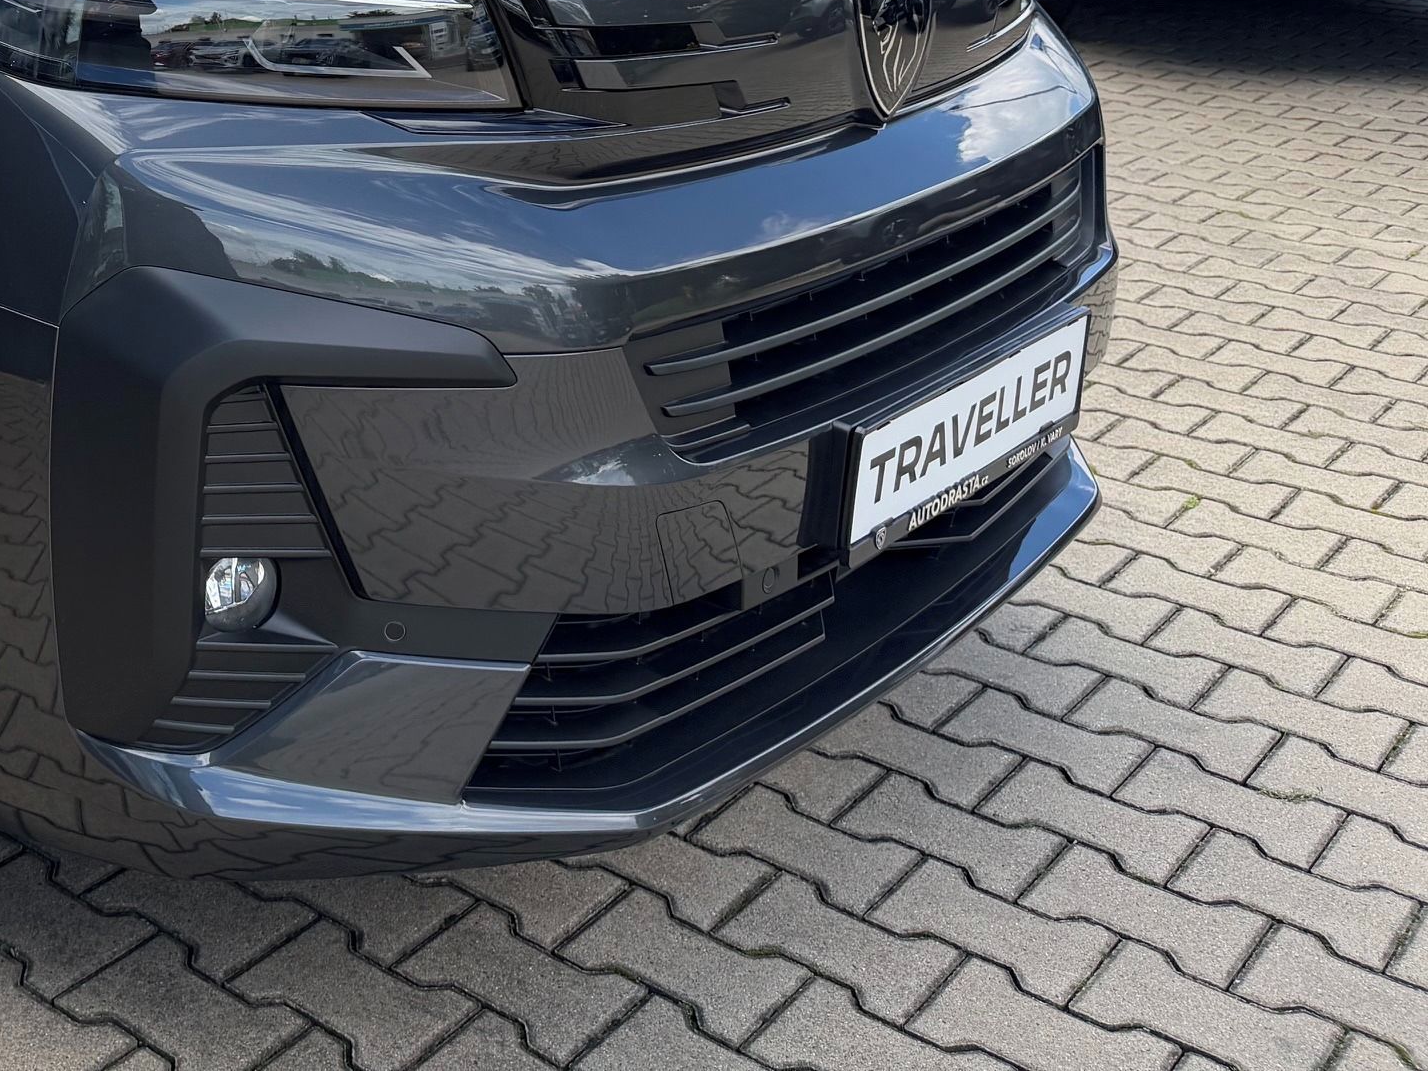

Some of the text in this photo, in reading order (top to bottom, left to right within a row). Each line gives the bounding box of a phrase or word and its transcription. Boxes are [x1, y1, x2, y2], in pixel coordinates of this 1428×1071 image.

[870, 350, 1072, 504] TRAVELLER
[1007, 442, 1037, 468] SOKOLOV
[1047, 426, 1063, 442] VARY
[908, 473, 989, 531] AUTODRASTA.cz
